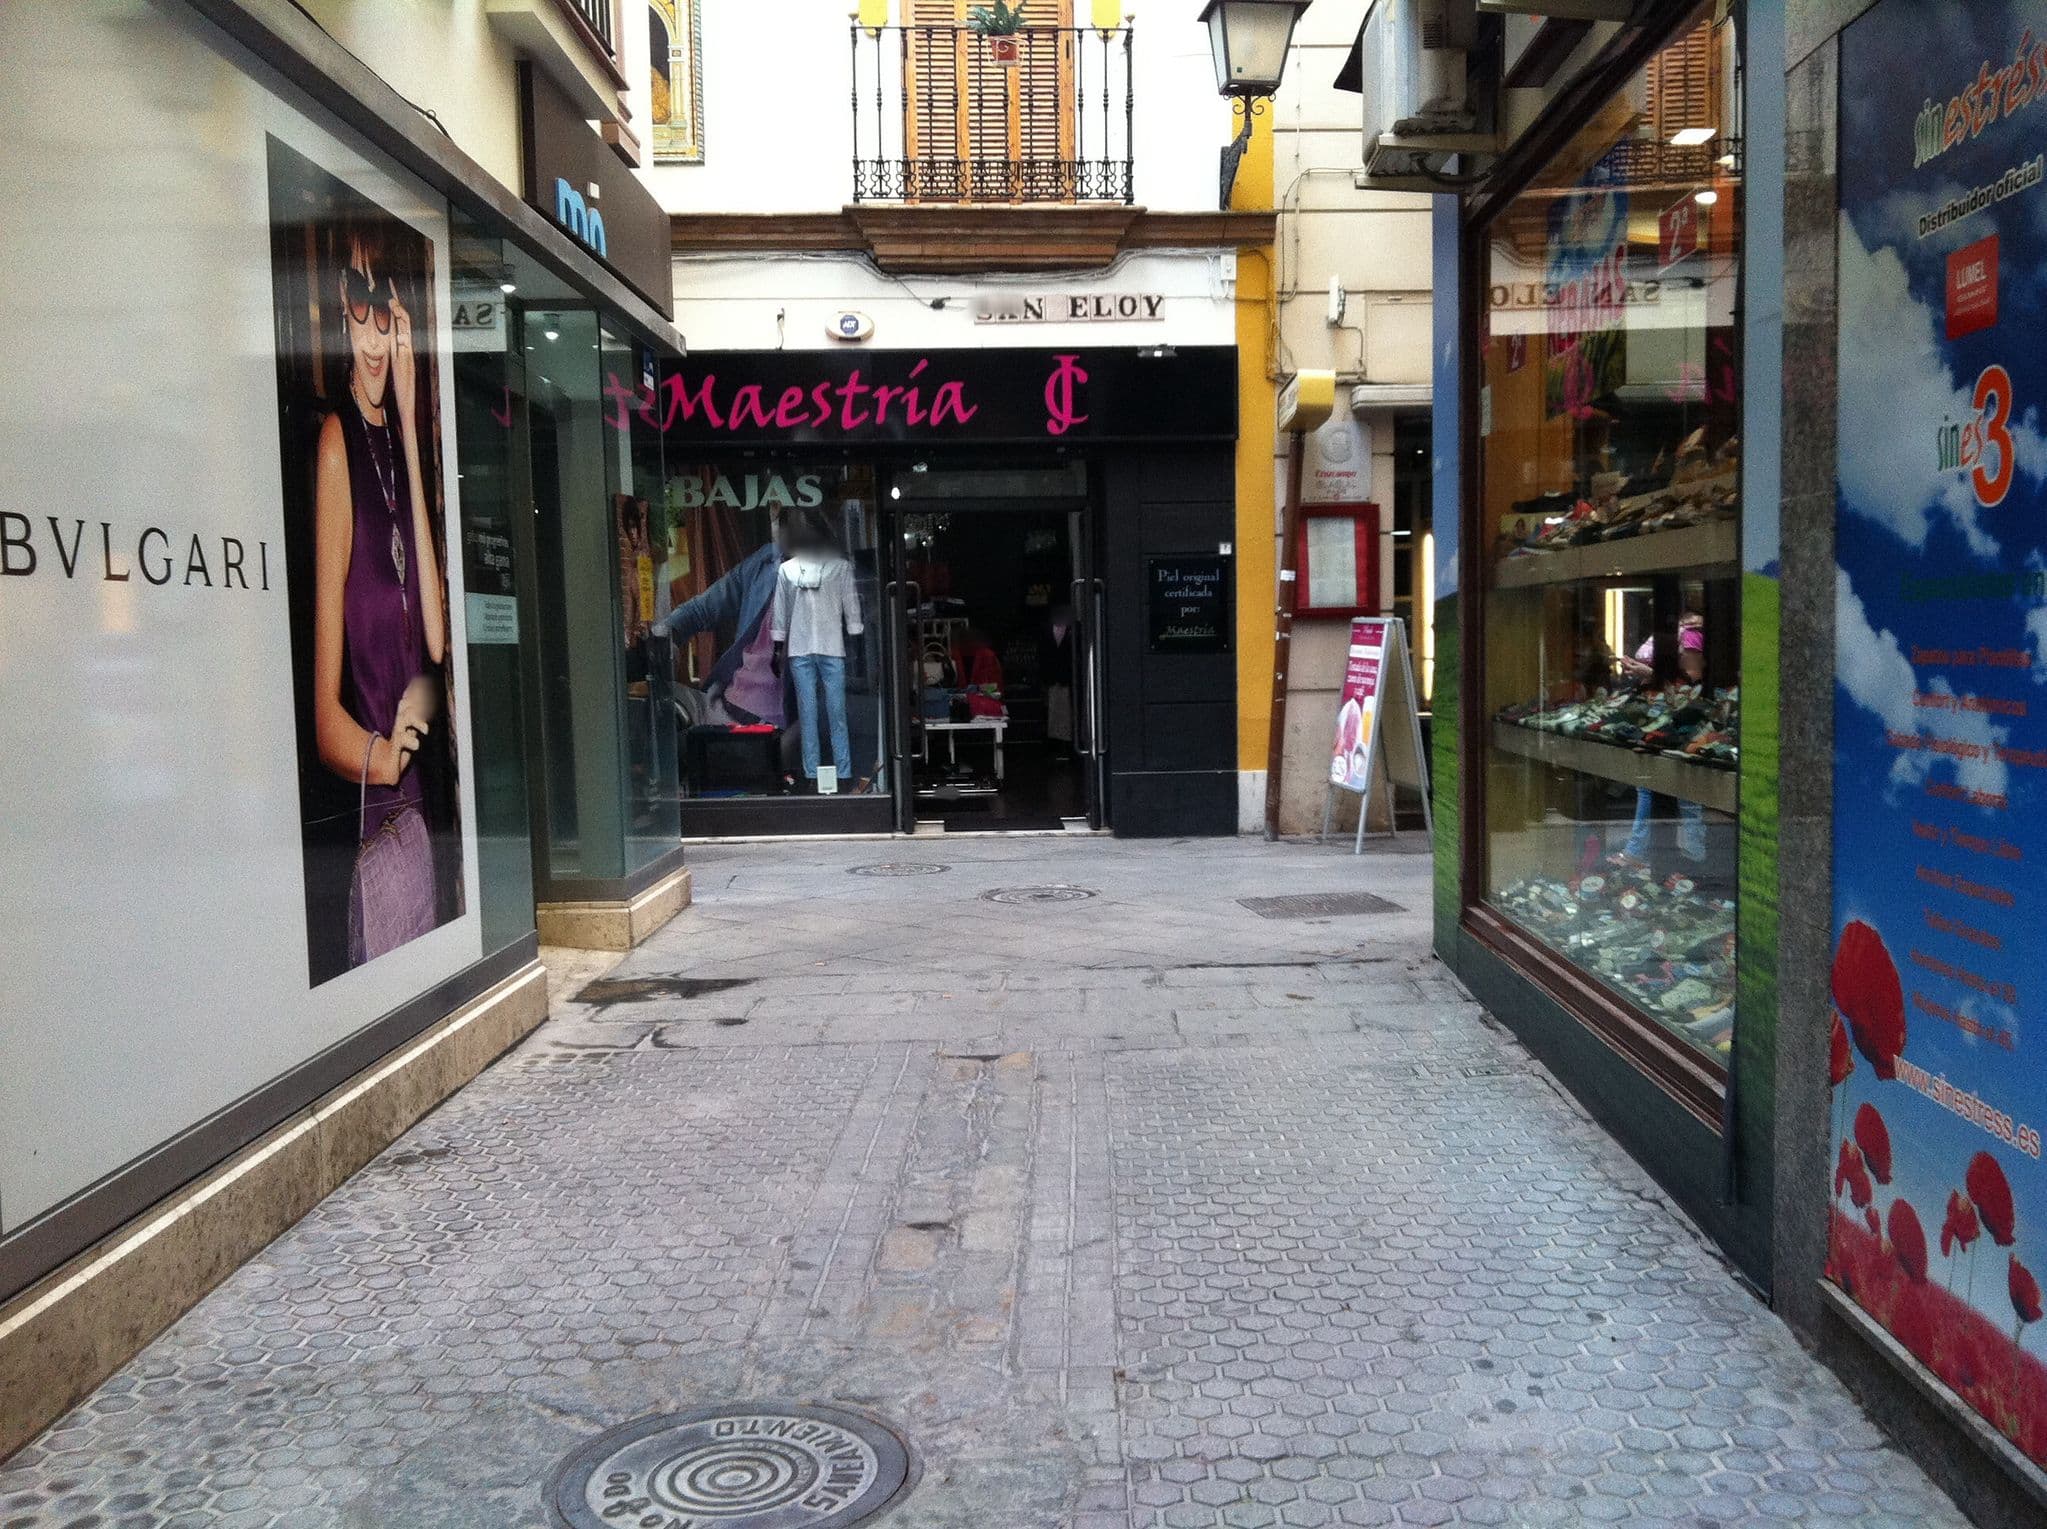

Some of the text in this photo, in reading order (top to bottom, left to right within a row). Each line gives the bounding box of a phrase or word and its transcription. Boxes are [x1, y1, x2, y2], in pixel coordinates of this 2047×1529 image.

[1918, 156, 2042, 237] Distribuidor oficial
[1069, 295, 1164, 318] ELOY
[661, 358, 978, 432] Maestría
[0, 511, 270, 591] BVLGARI
[1158, 568, 1220, 585] Piel original
[1164, 584, 1213, 597] certificada
[1893, 1055, 2042, 1160] www.sinestress.es
[714, 1419, 866, 1511] SANEAMIENTO
